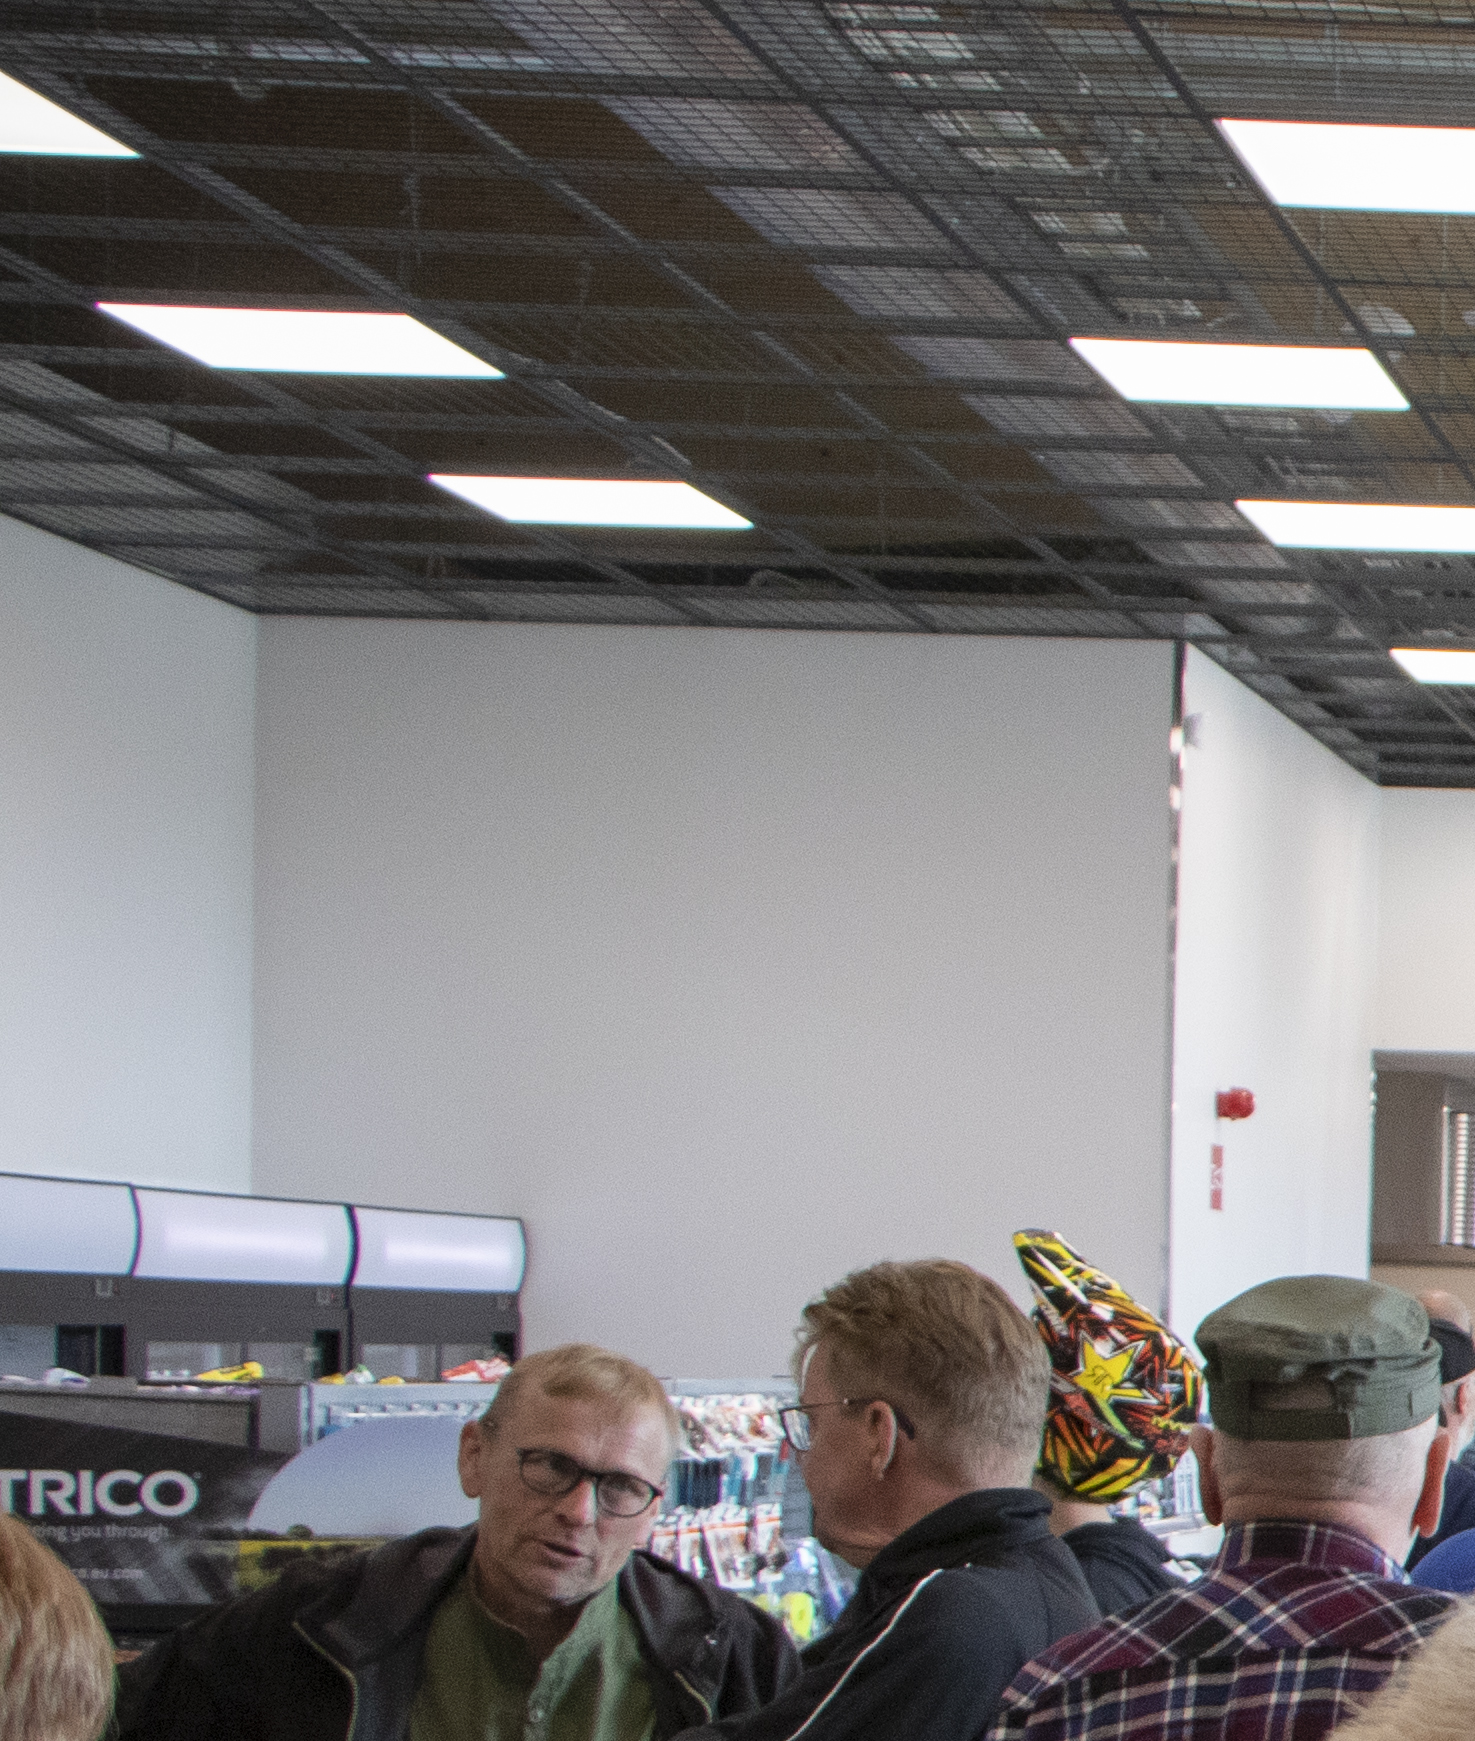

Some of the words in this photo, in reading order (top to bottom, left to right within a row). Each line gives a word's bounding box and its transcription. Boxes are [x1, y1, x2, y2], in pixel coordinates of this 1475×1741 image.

[0, 1469, 200, 1517] TRICO
[71, 1526, 101, 1542] you
[105, 1523, 170, 1543] through
